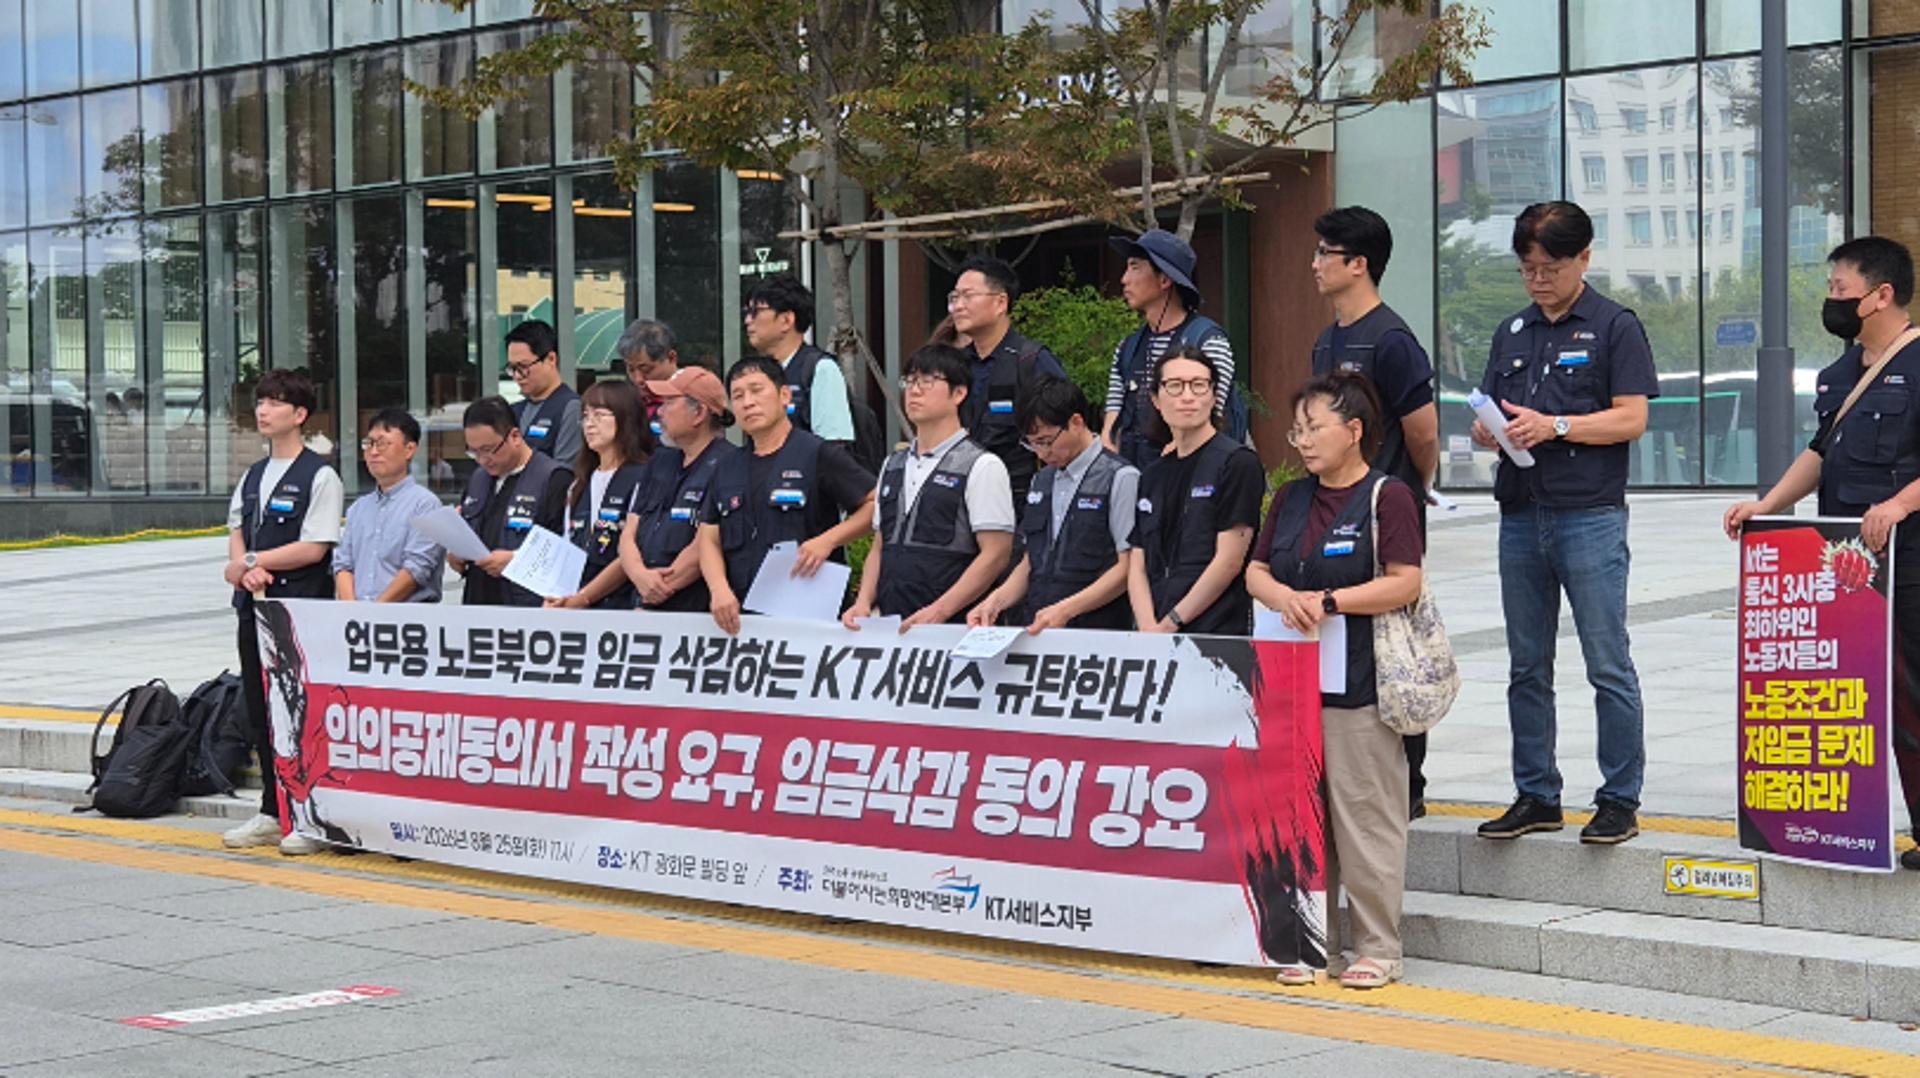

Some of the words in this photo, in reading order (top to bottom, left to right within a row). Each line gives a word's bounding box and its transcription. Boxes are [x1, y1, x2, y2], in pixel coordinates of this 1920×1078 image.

[1744, 575, 1779, 606] 통신
[1782, 571, 1836, 603] 3사중
[1744, 606, 1817, 639] 최하위인
[344, 619, 429, 677] 업무용
[435, 625, 587, 684] 노트북으로
[593, 630, 662, 691] 임금
[668, 634, 806, 699] 삭감하는
[810, 644, 985, 710] KT서비스
[995, 653, 1178, 724] 규탄한다!
[1744, 638, 1838, 672] 노동자들의
[1744, 678, 1869, 719] 노동조건과
[1744, 724, 1812, 765] 저임금
[1818, 724, 1874, 766] 문제
[325, 703, 576, 790] 임의공제동의서
[580, 725, 670, 800] 작성
[671, 730, 764, 812] 요구,
[773, 736, 970, 829] 임금삭감
[972, 754, 1086, 839] 동의
[1089, 766, 1209, 851] 강요
[1744, 770, 1850, 812] 해결하라!
[390, 821, 420, 842] 일시:
[470, 830, 493, 854] 8월
[597, 845, 628, 869] 장소:
[629, 850, 652, 872] KT
[655, 852, 696, 879] 광화문
[701, 858, 729, 883] 빌딩
[733, 861, 748, 885] 앞
[777, 866, 814, 893] 주최:
[985, 895, 1093, 932] KT서비스지부
